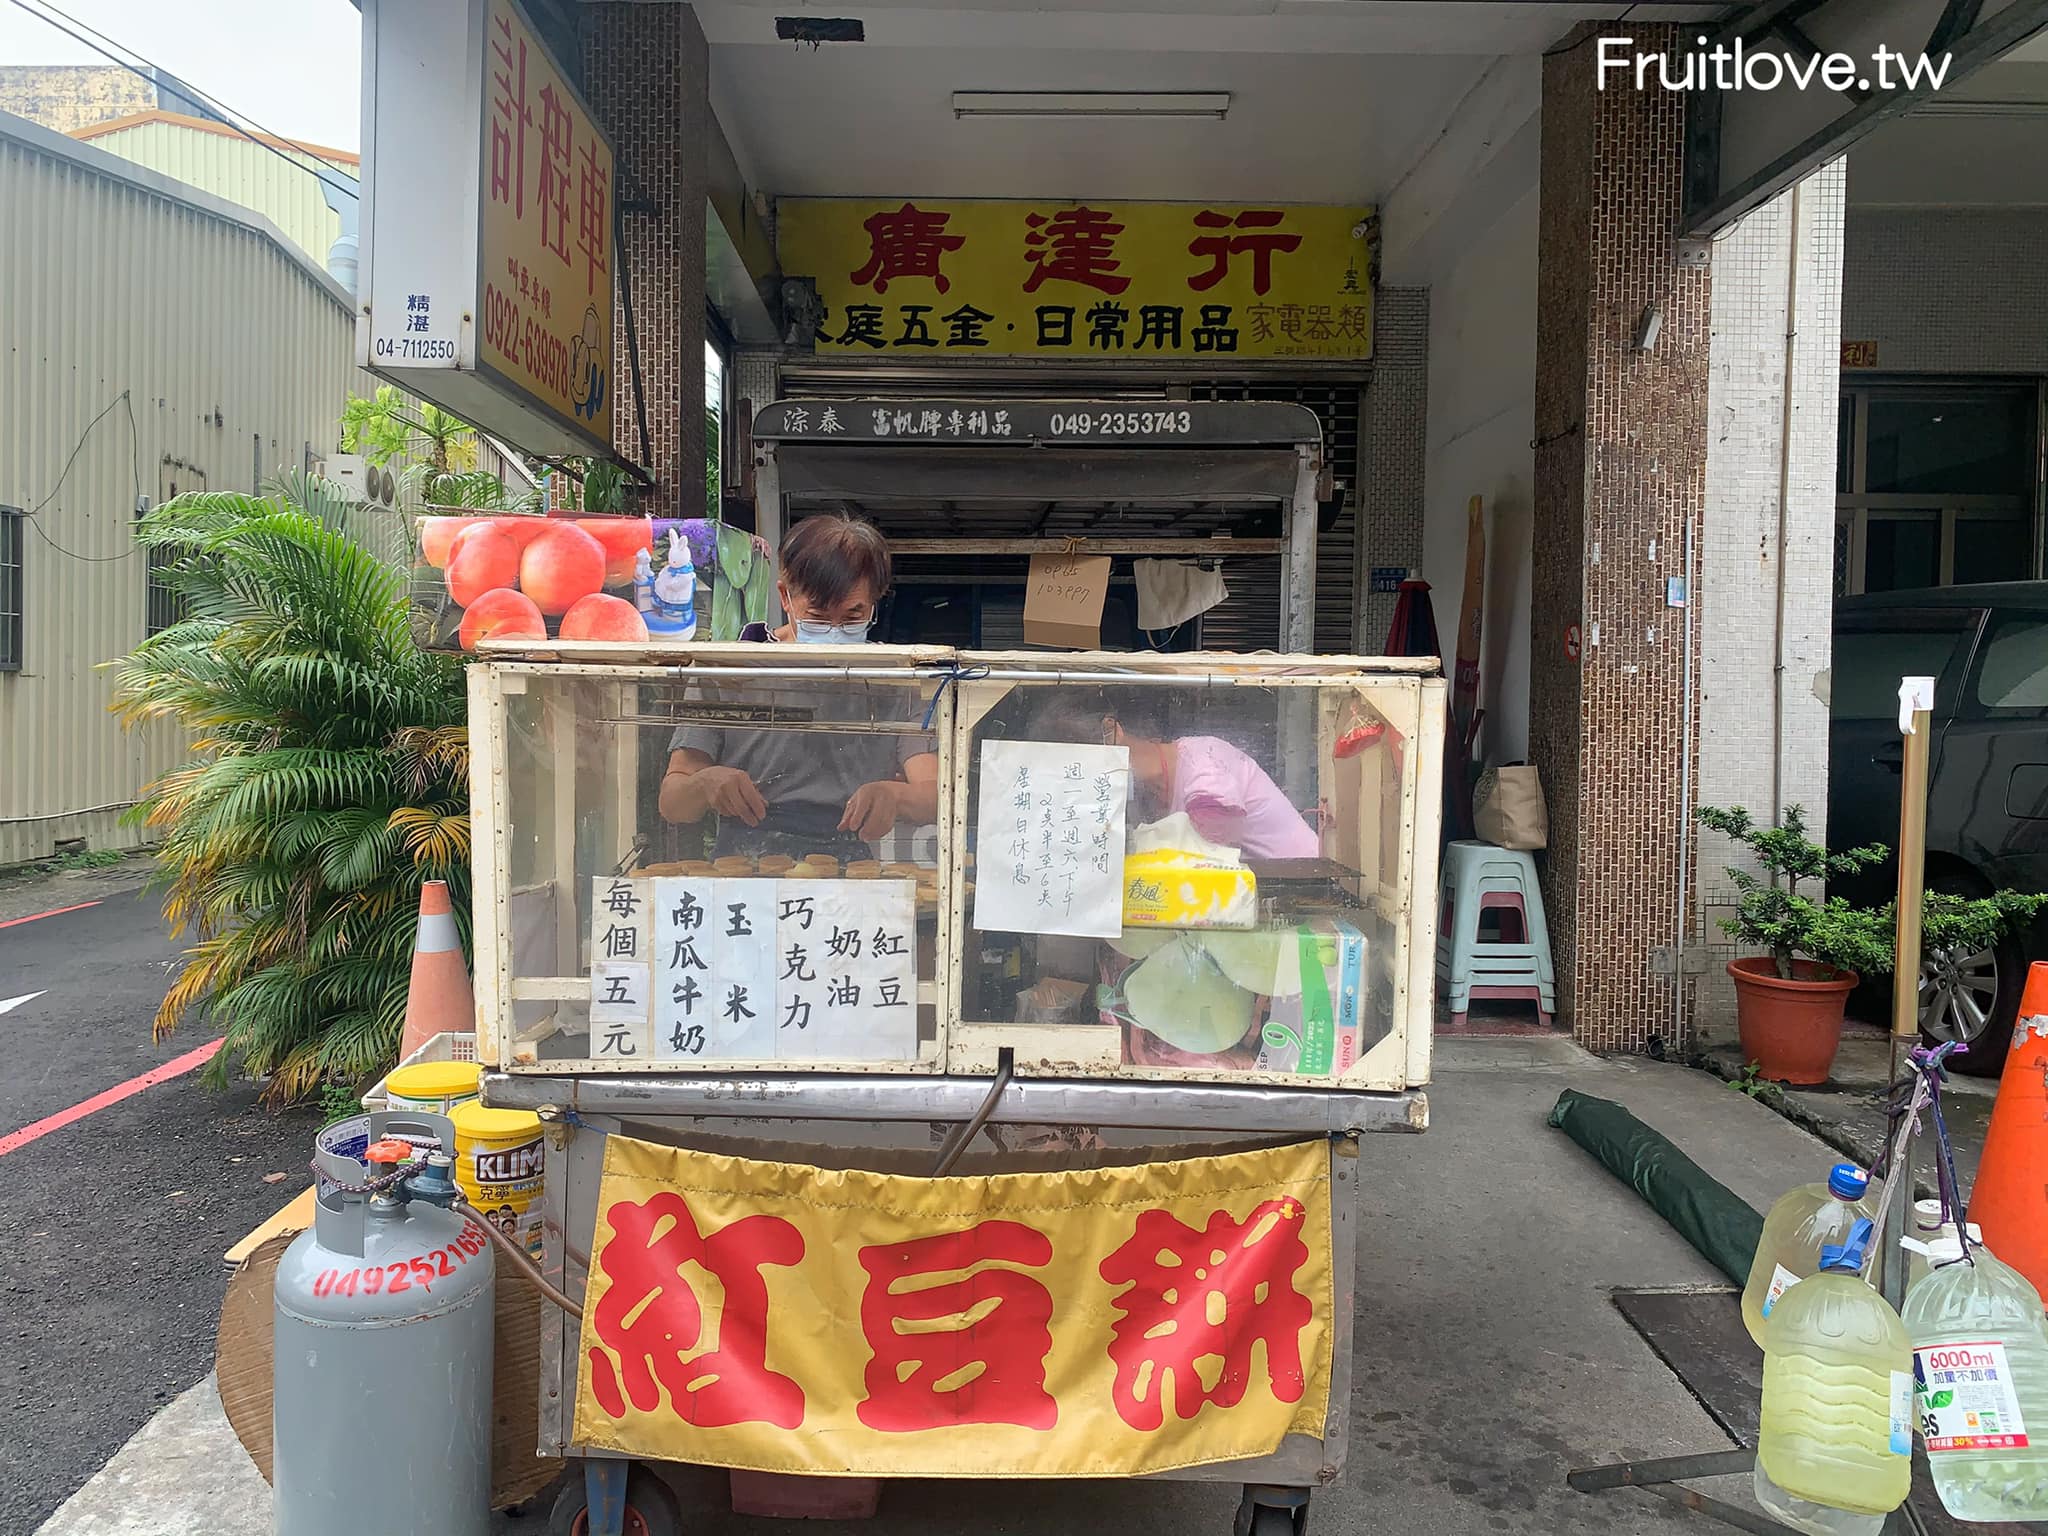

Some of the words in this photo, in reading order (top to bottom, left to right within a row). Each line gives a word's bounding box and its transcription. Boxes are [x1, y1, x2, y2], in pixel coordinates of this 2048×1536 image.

[490, 13, 608, 297] 計程車
[850, 201, 1304, 297] 廣達行
[376, 337, 455, 361] 04-7112550
[406, 294, 431, 334] 精湛
[484, 281, 569, 400] 0922-639978
[1246, 303, 1368, 345] 家電器類
[1050, 410, 1192, 436] 049-2353743
[1008, 765, 1031, 887] 星期日休息
[1090, 774, 1112, 874] 營業時間
[599, 879, 643, 1057] 每個五元
[669, 890, 709, 1056] 南瓜牛奶
[723, 902, 757, 1024] 玉米
[778, 896, 817, 1030] 巧克力
[824, 924, 863, 1008] 奶油
[871, 925, 910, 1009] 紅豆
[1259, 1051, 1269, 1070] SEP
[589, 1190, 1313, 1432] 紅豆餅
[1929, 1349, 1995, 1369] 6000ml
